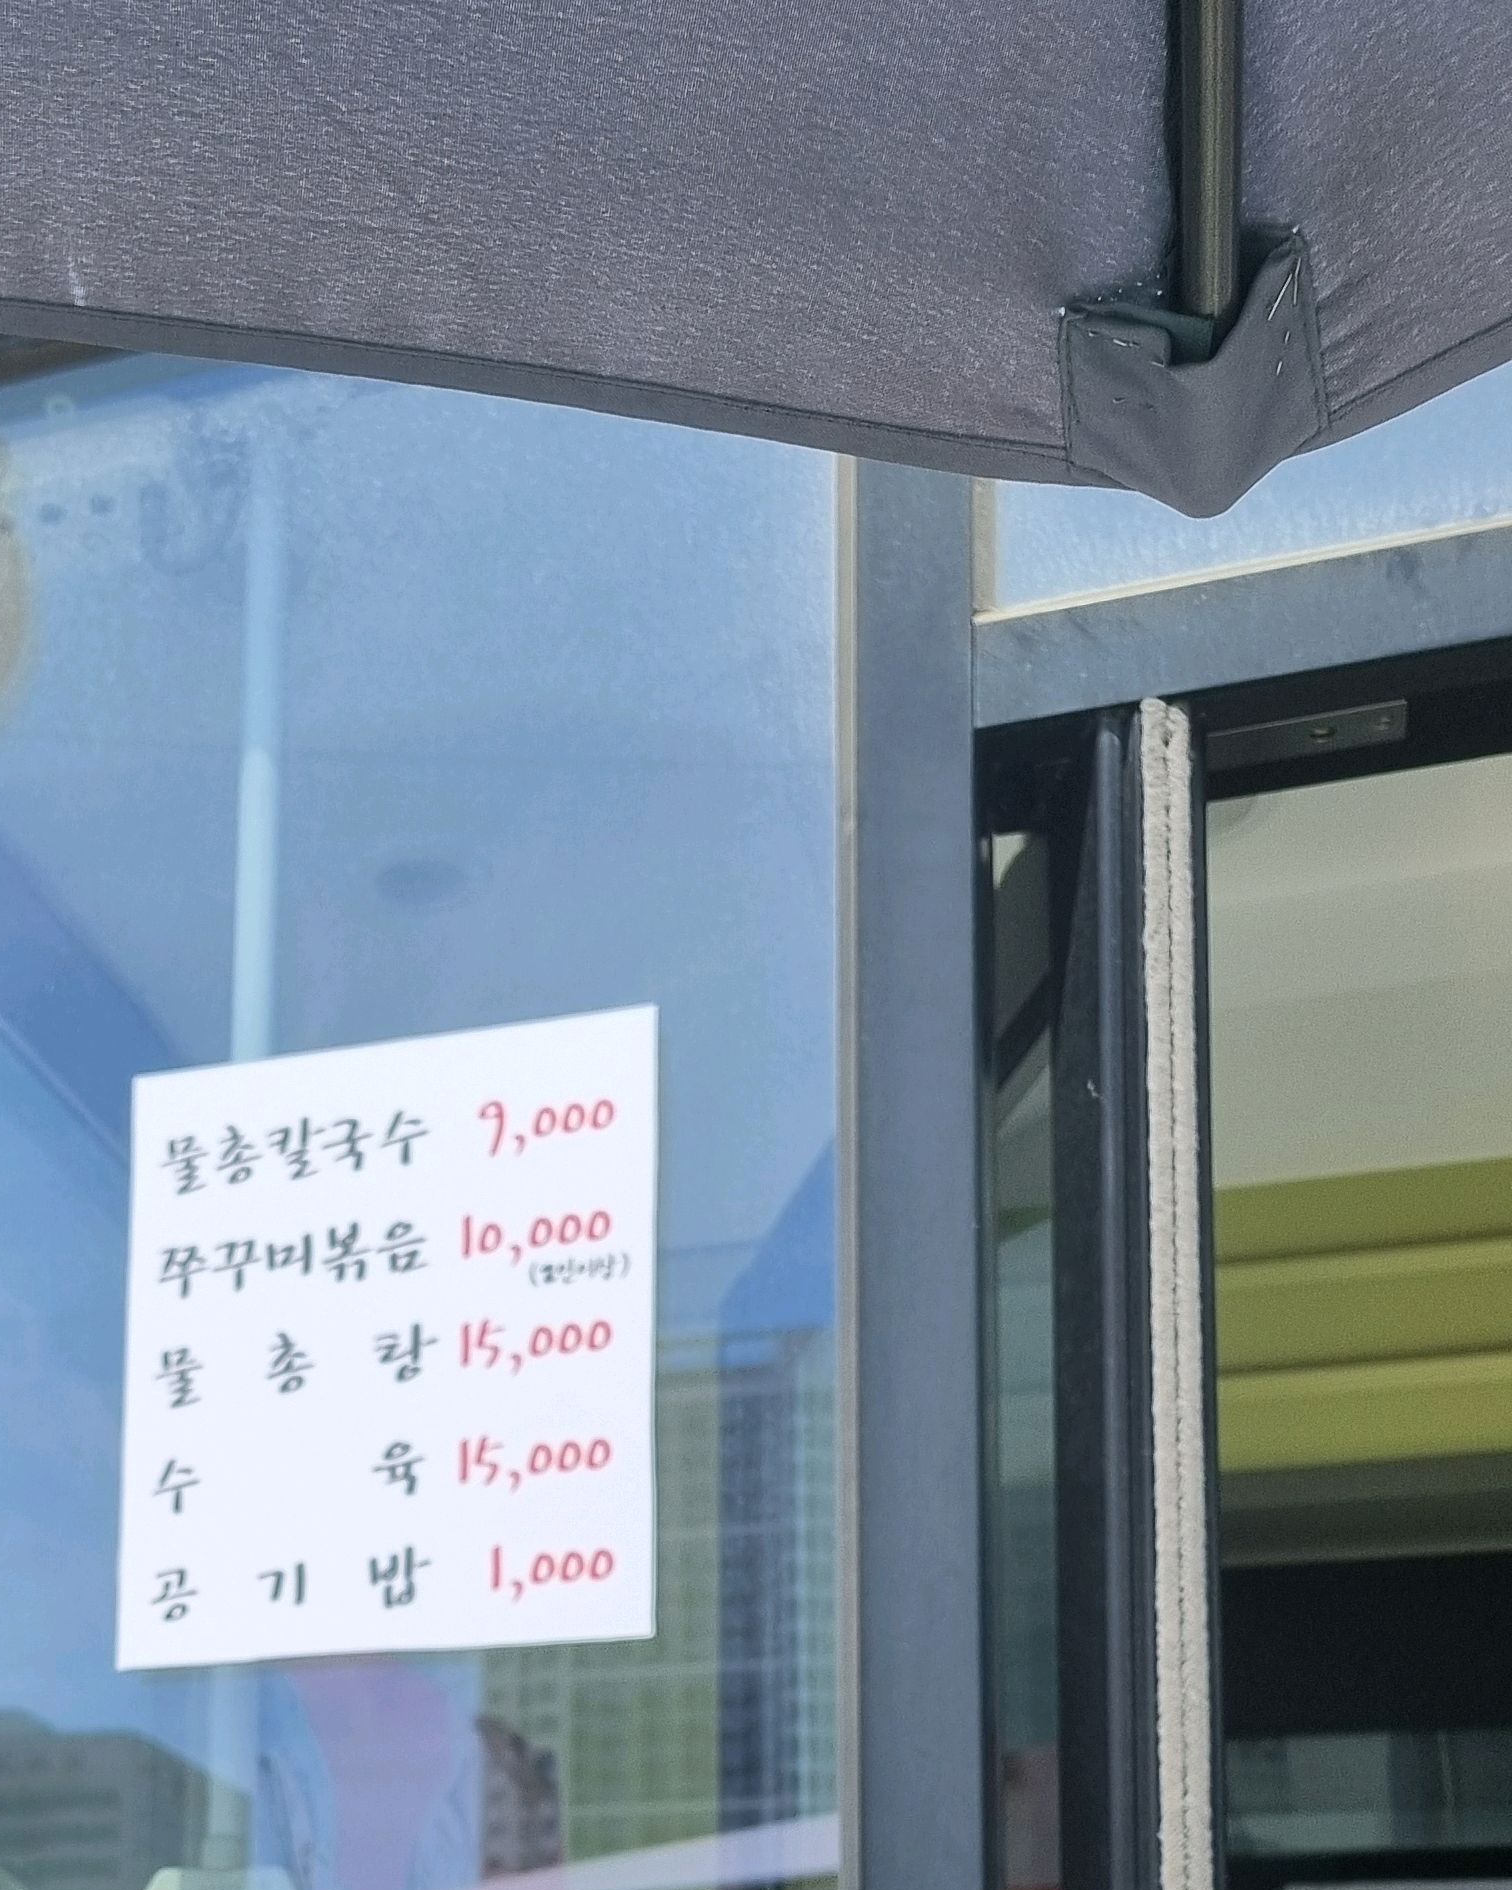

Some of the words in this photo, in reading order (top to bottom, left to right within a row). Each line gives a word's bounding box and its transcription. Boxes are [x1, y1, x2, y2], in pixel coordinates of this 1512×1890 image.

[161, 1110, 430, 1195] 물총칼국수
[479, 1099, 615, 1158] 9,000
[462, 1209, 612, 1267] 10,000
[460, 1319, 614, 1377] 15,000
[457, 1436, 613, 1492] 15,000
[489, 1545, 616, 1602] 1,000
